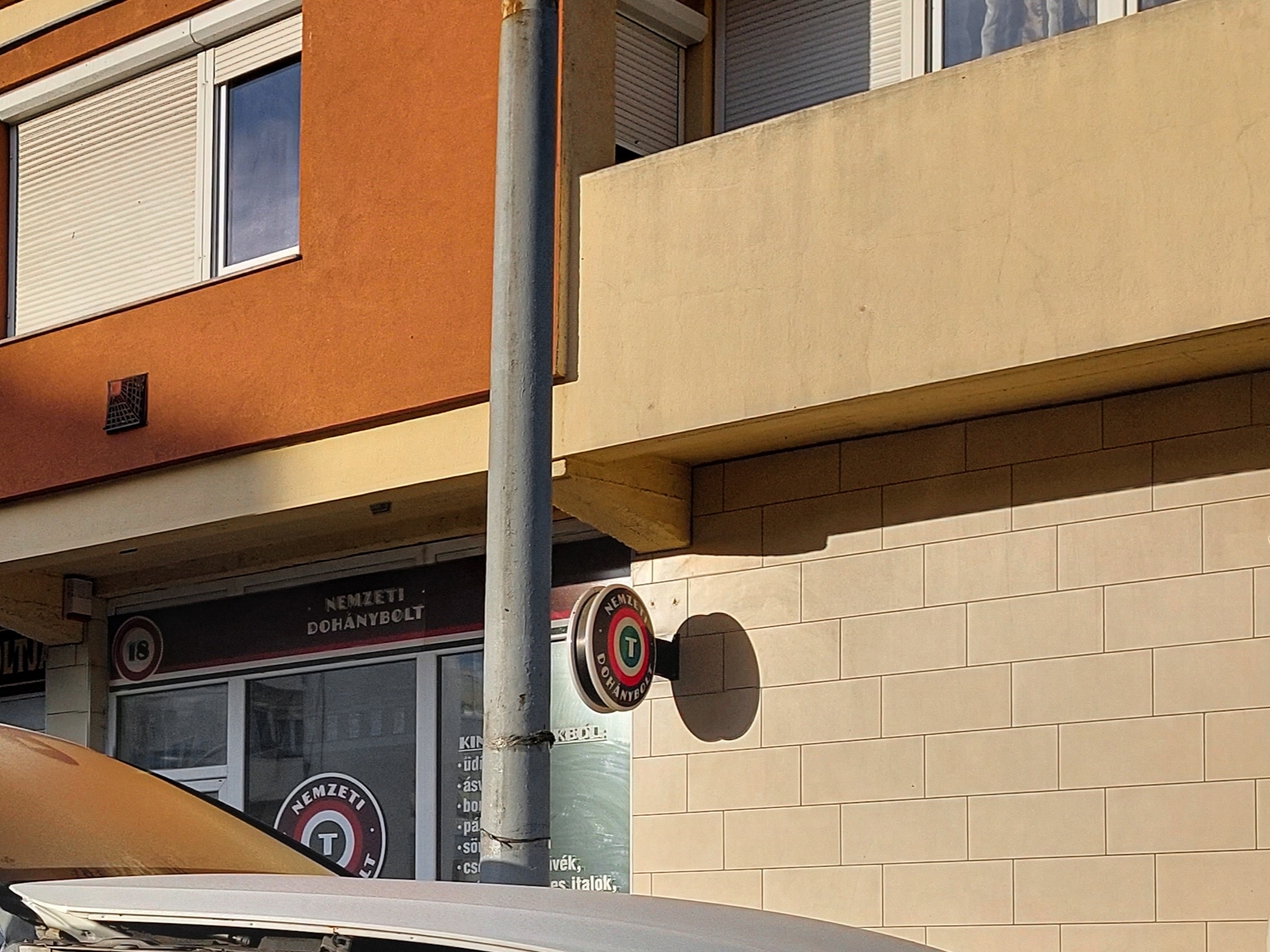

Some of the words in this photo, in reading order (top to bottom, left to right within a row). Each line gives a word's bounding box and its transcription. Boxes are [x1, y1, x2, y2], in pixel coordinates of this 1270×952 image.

[326, 588, 405, 612] NEMZETI
[604, 593, 648, 623] NEMZETI
[307, 605, 426, 636] DOHÁNYBOLT
[127, 636, 151, 662] 18
[624, 636, 638, 658] T
[291, 783, 366, 816] NEMZETI
[317, 833, 338, 856] T
